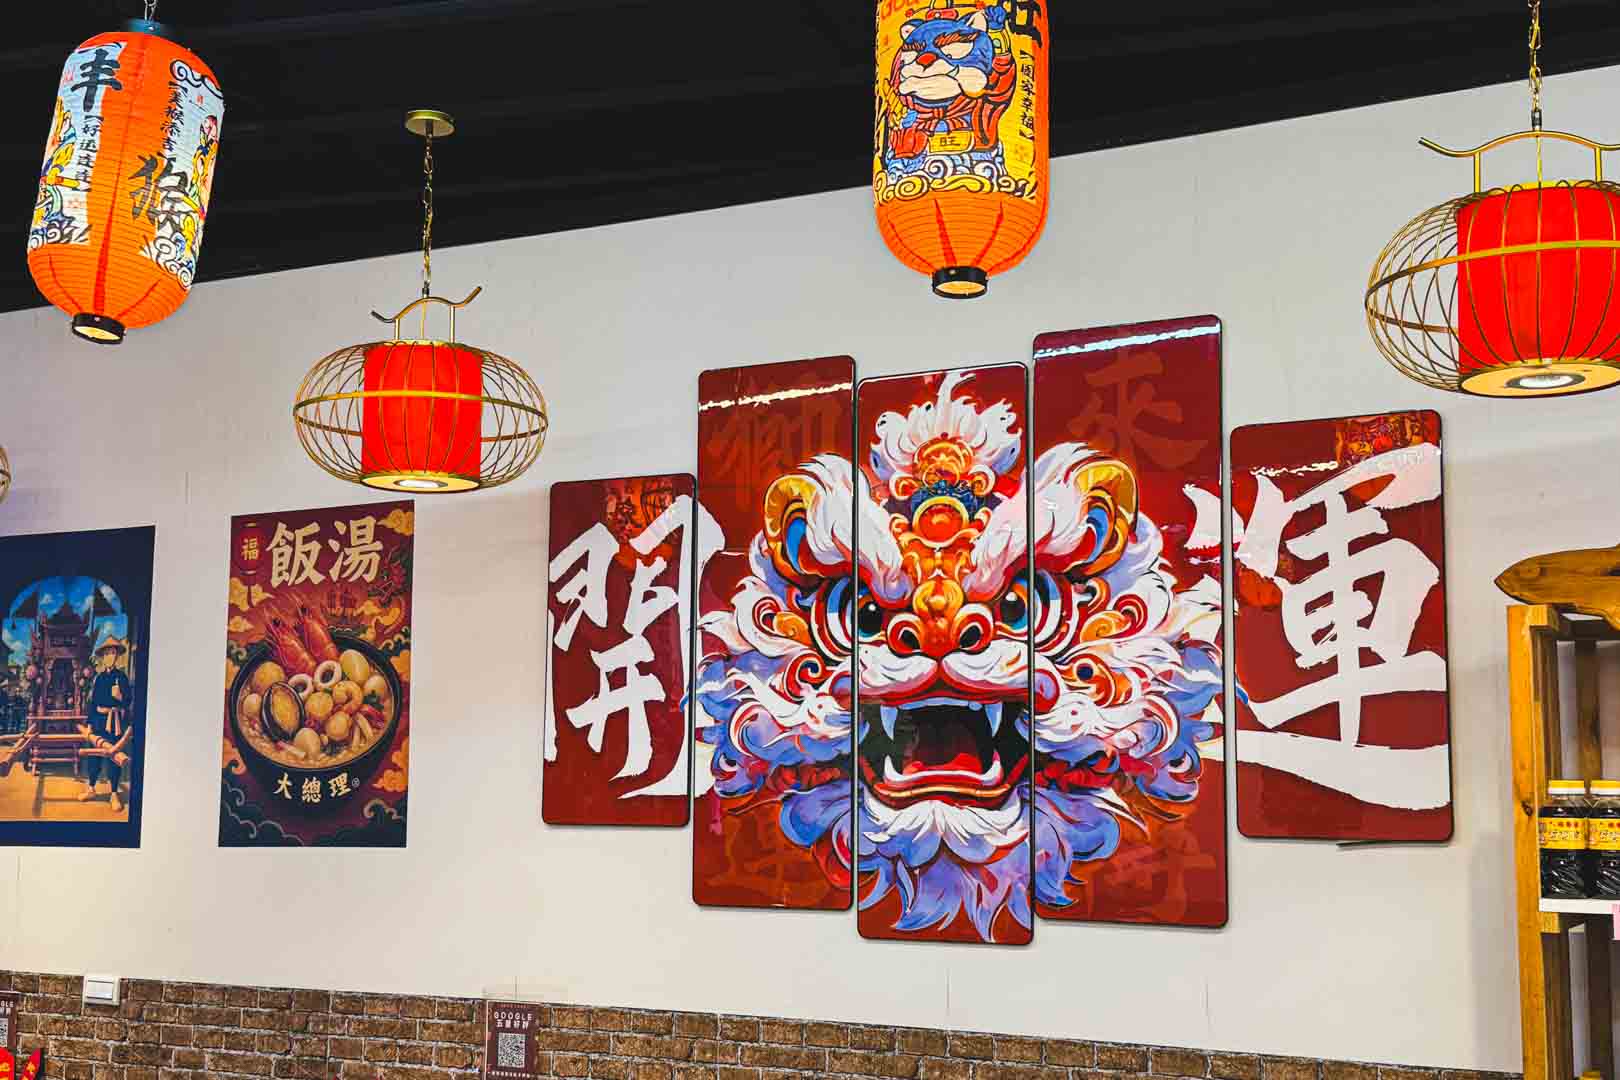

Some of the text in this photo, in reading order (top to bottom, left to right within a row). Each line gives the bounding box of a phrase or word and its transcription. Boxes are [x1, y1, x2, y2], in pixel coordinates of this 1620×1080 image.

[241, 536, 260, 561] 福
[265, 514, 384, 588] 飯湯
[543, 494, 726, 800] 開
[1182, 441, 1449, 811] 運
[272, 771, 352, 803] 大總理
[493, 1011, 534, 1021] GOOGLE
